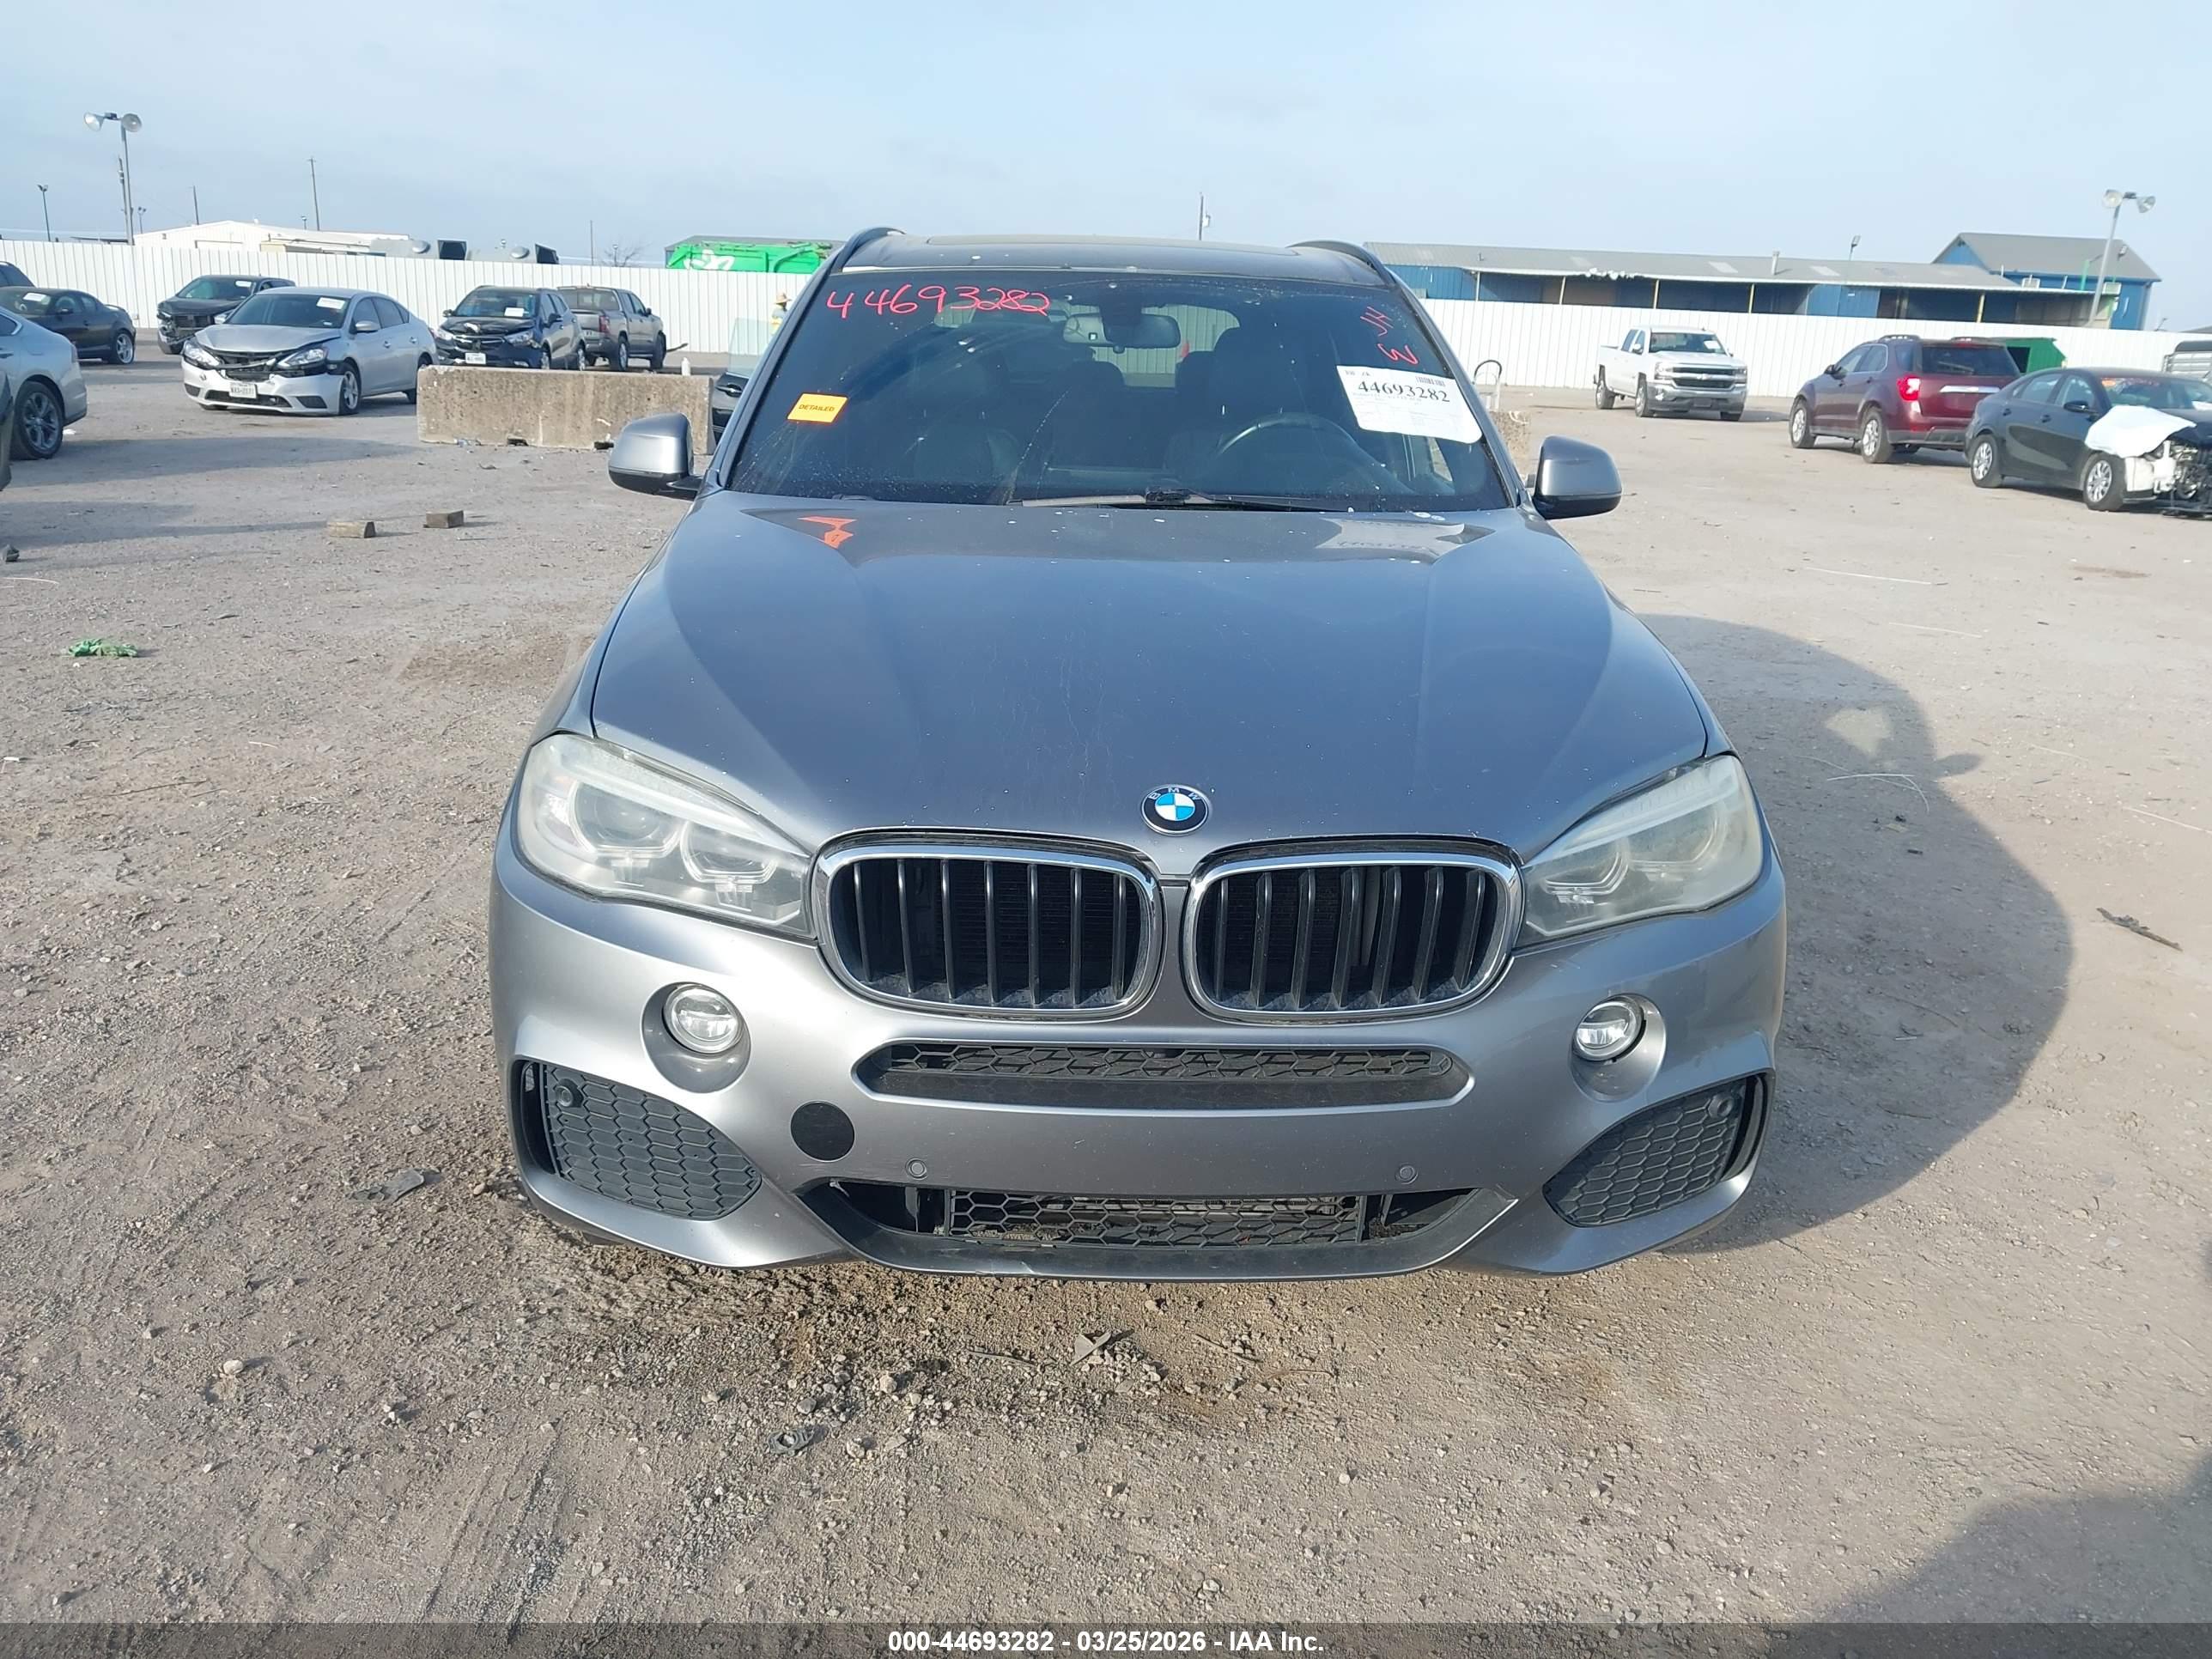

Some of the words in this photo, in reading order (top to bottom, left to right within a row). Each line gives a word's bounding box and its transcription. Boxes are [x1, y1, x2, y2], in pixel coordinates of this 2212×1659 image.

[826, 284, 1050, 319] 44693282
[1358, 380, 1450, 403] 44693282
[1147, 787, 1201, 800] BMW
